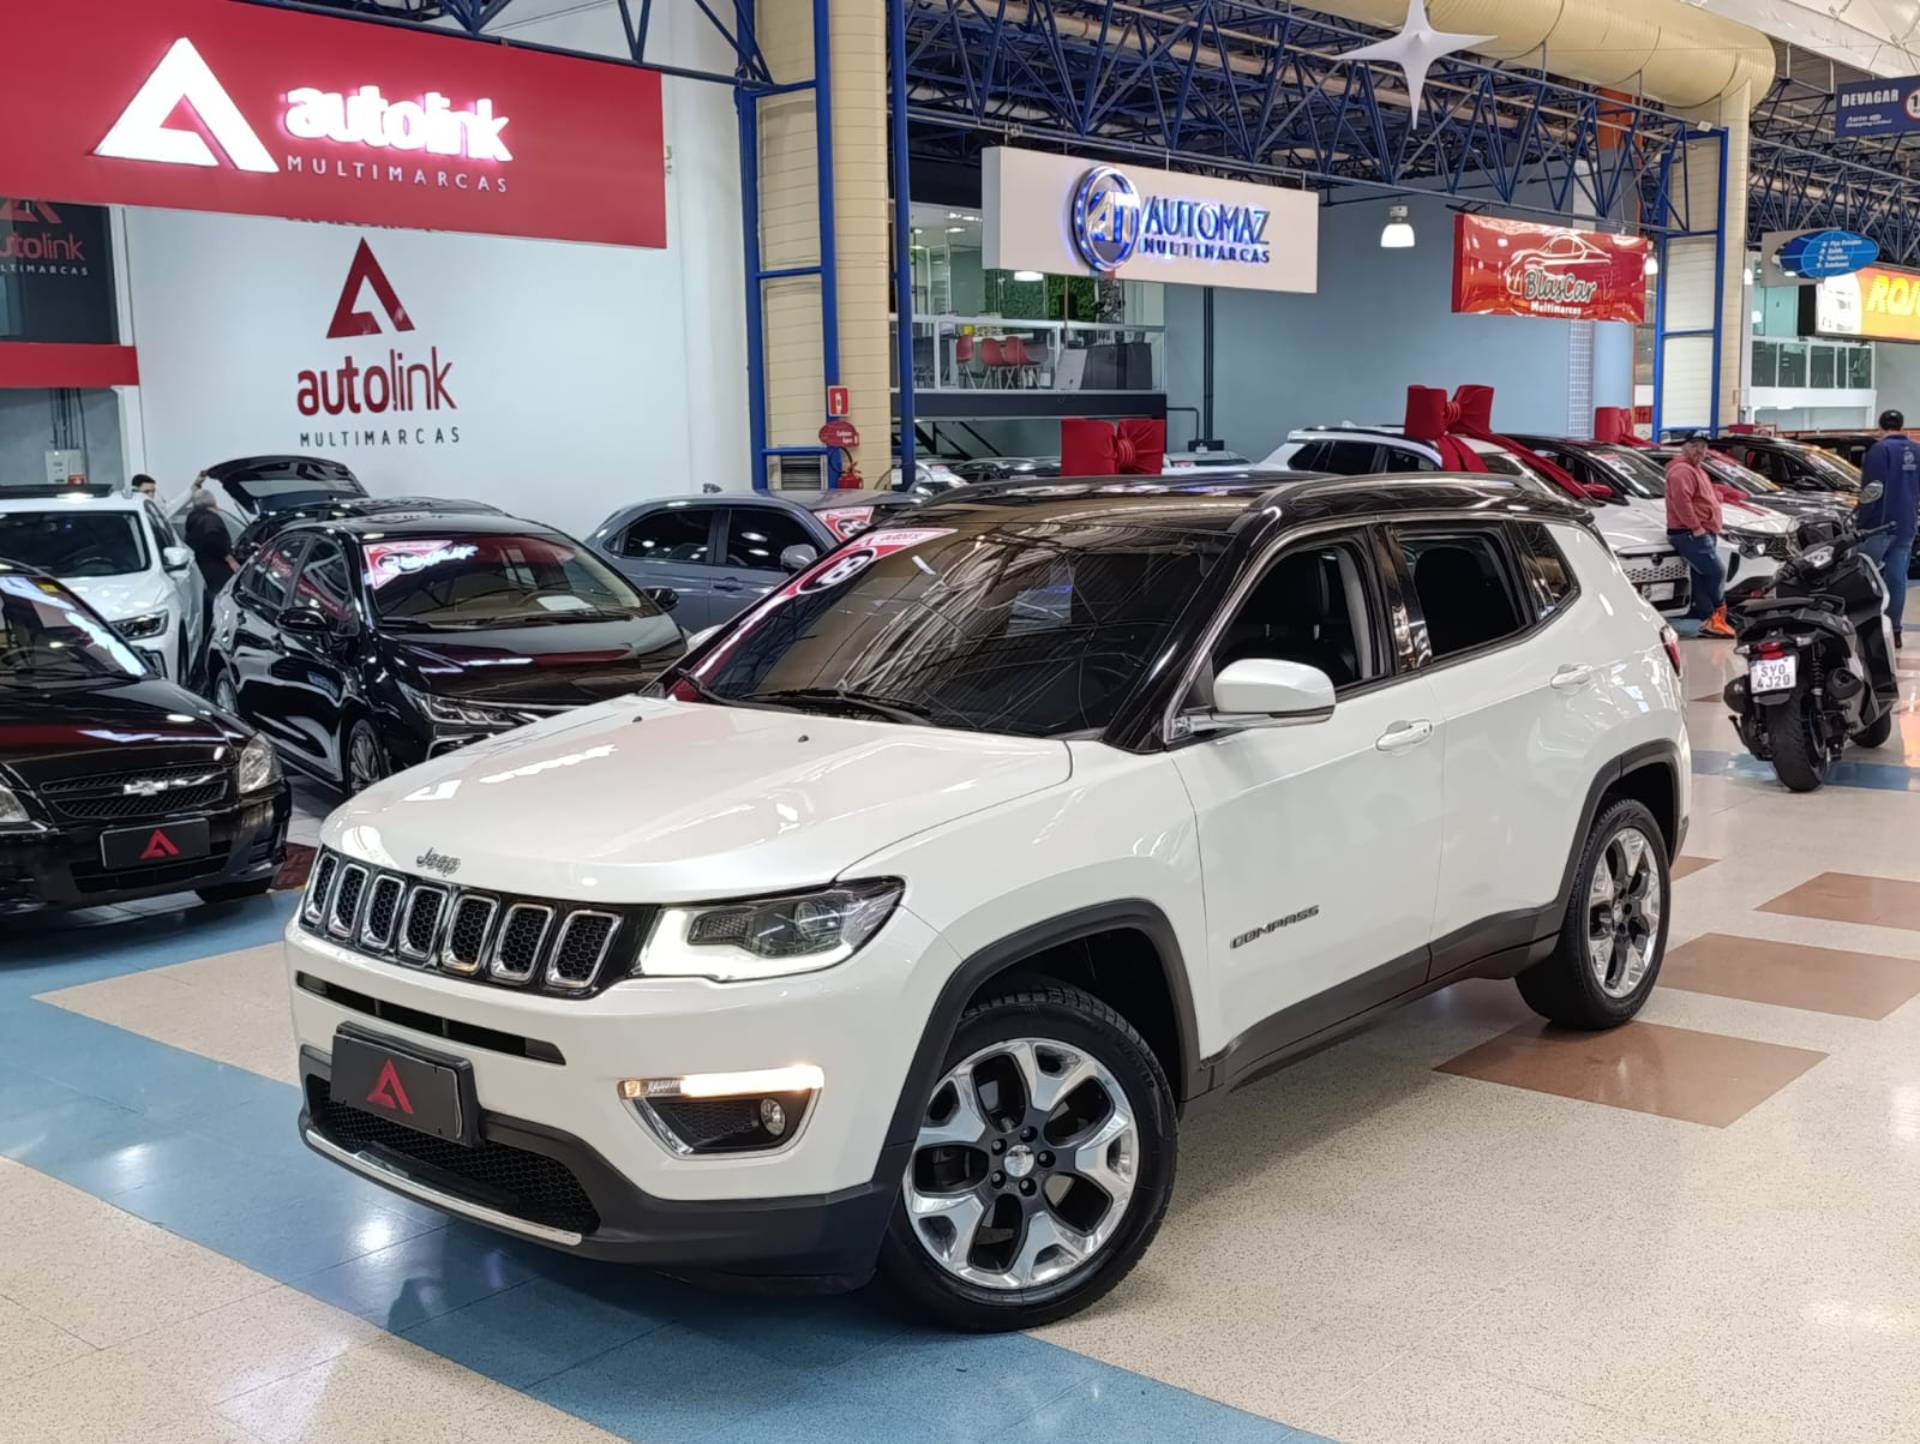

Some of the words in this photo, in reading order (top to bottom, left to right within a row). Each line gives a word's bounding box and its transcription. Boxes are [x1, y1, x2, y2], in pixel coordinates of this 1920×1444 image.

[1841, 88, 1899, 107] DEVAGAR
[285, 85, 514, 161] autolink
[286, 155, 508, 192] MULTIMARCAS
[1143, 195, 1271, 245] AUTOMAZ
[0, 232, 86, 261] utolink
[1143, 237, 1270, 263] MULTIMARCAS
[0, 264, 88, 276] LTIMARCAS
[296, 346, 458, 416] autolink
[300, 427, 460, 447] MULTIMARCAS
[416, 847, 461, 877] Jeep
[1230, 904, 1319, 949] COMPASS
